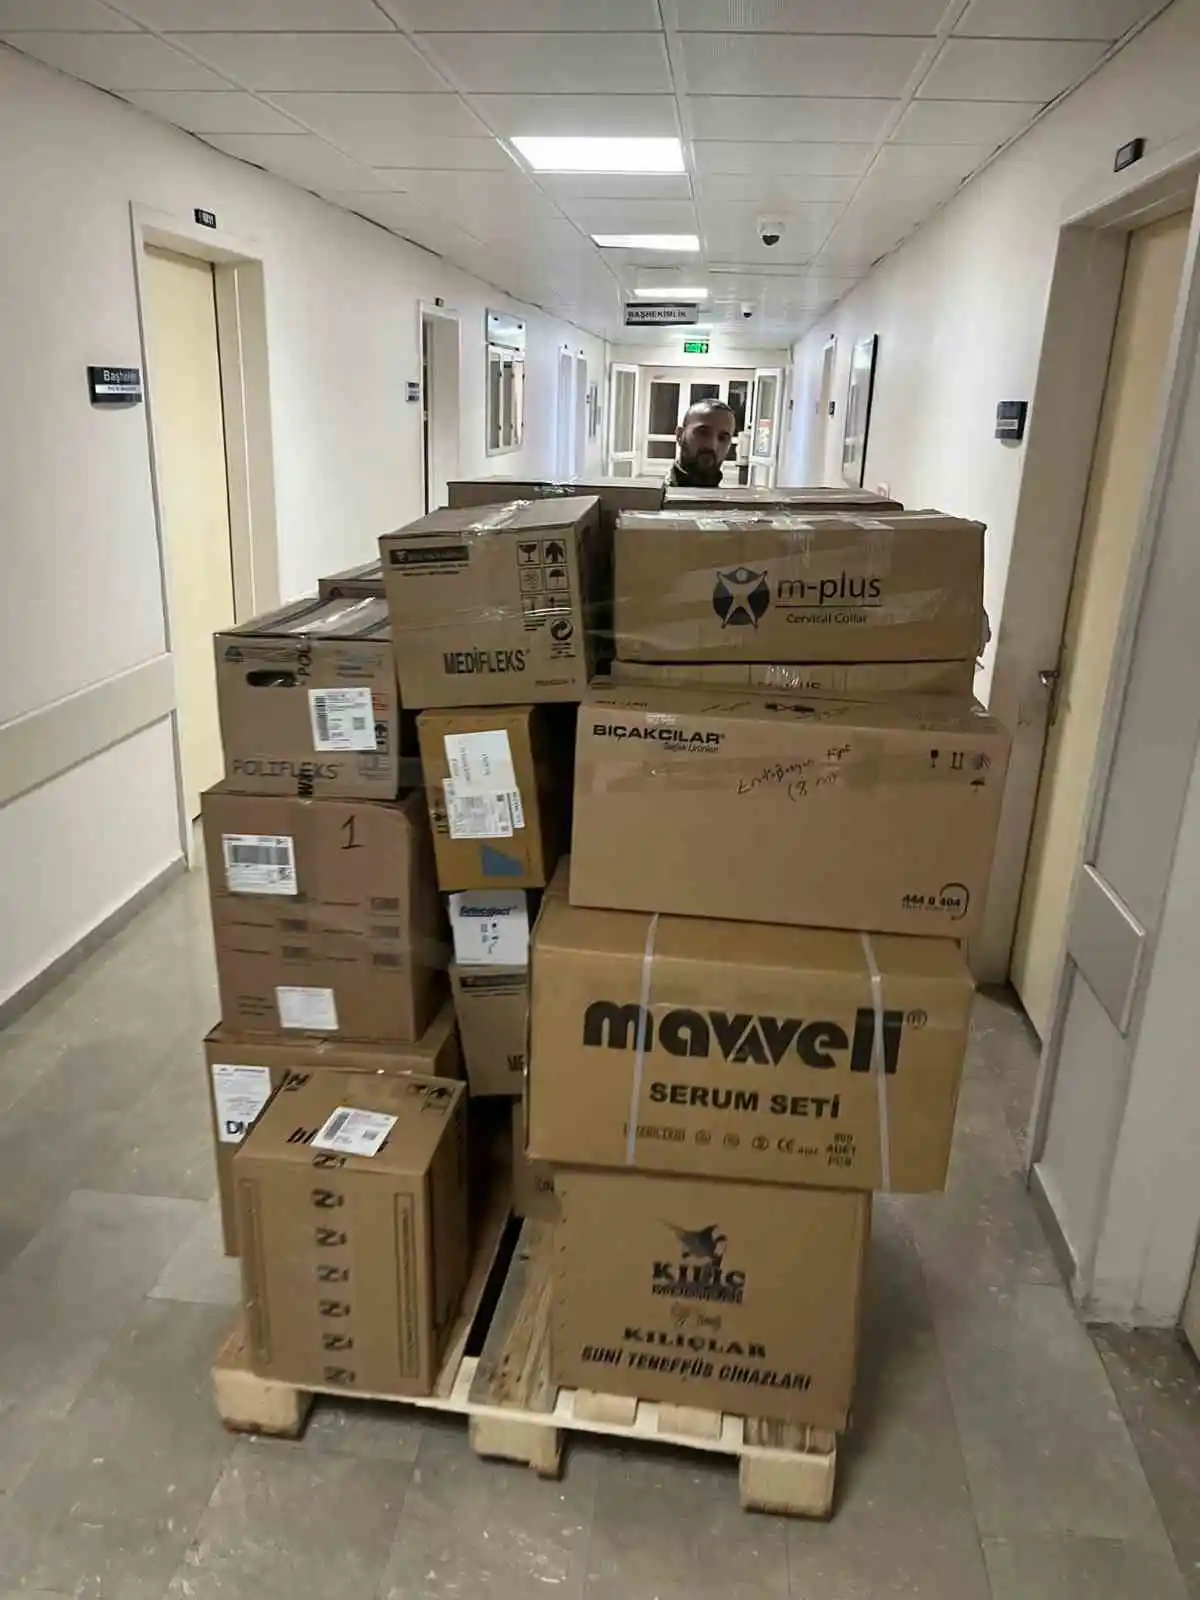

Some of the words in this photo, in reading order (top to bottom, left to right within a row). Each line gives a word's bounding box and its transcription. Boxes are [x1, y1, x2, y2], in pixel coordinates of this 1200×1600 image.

[778, 570, 881, 605] m-plus
[786, 613, 831, 625] Cervical
[834, 613, 868, 625] Collar
[443, 646, 527, 675] MEDİFLEKS
[340, 814, 367, 850] 1
[649, 1081, 760, 1113] SERUM
[769, 1093, 842, 1120] SETİ
